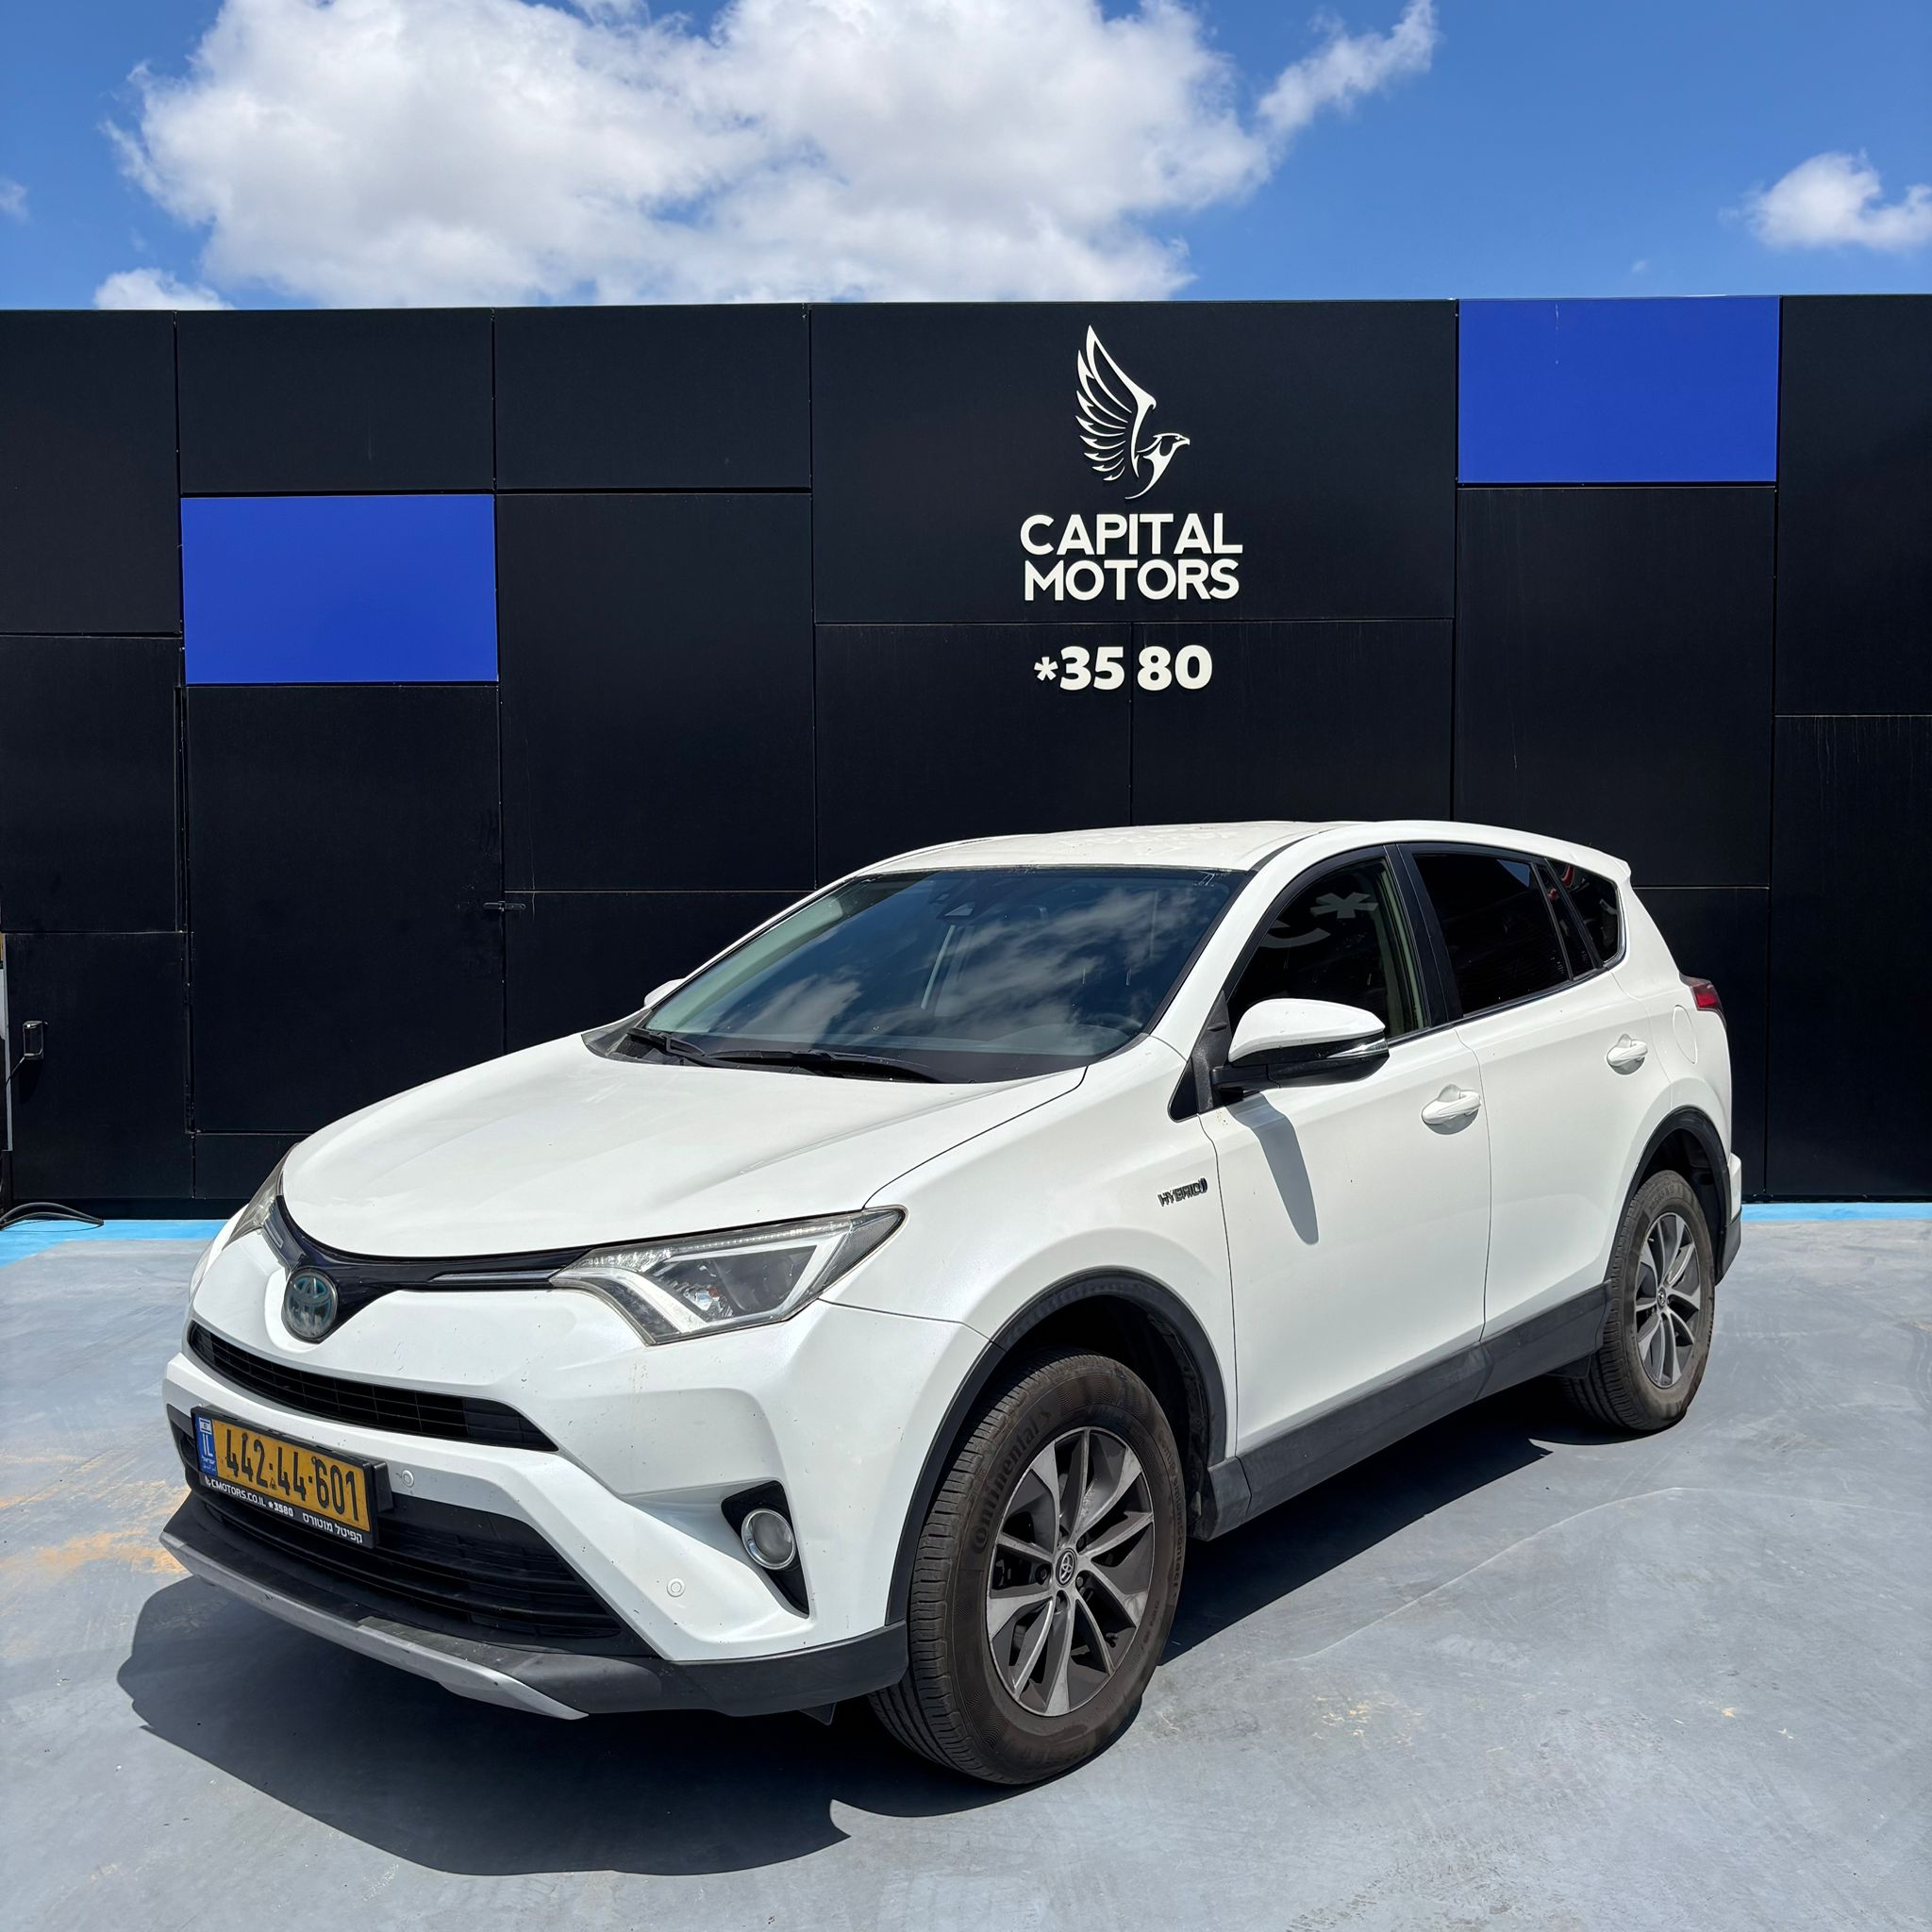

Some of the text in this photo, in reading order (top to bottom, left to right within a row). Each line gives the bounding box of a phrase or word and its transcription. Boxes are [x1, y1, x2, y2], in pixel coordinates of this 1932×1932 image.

[1020, 513, 1243, 556] CAPITAL
[1024, 558, 1240, 601] MOTORS
[1157, 1182, 1203, 1208] HYBRID
[202, 1433, 214, 1457] IL
